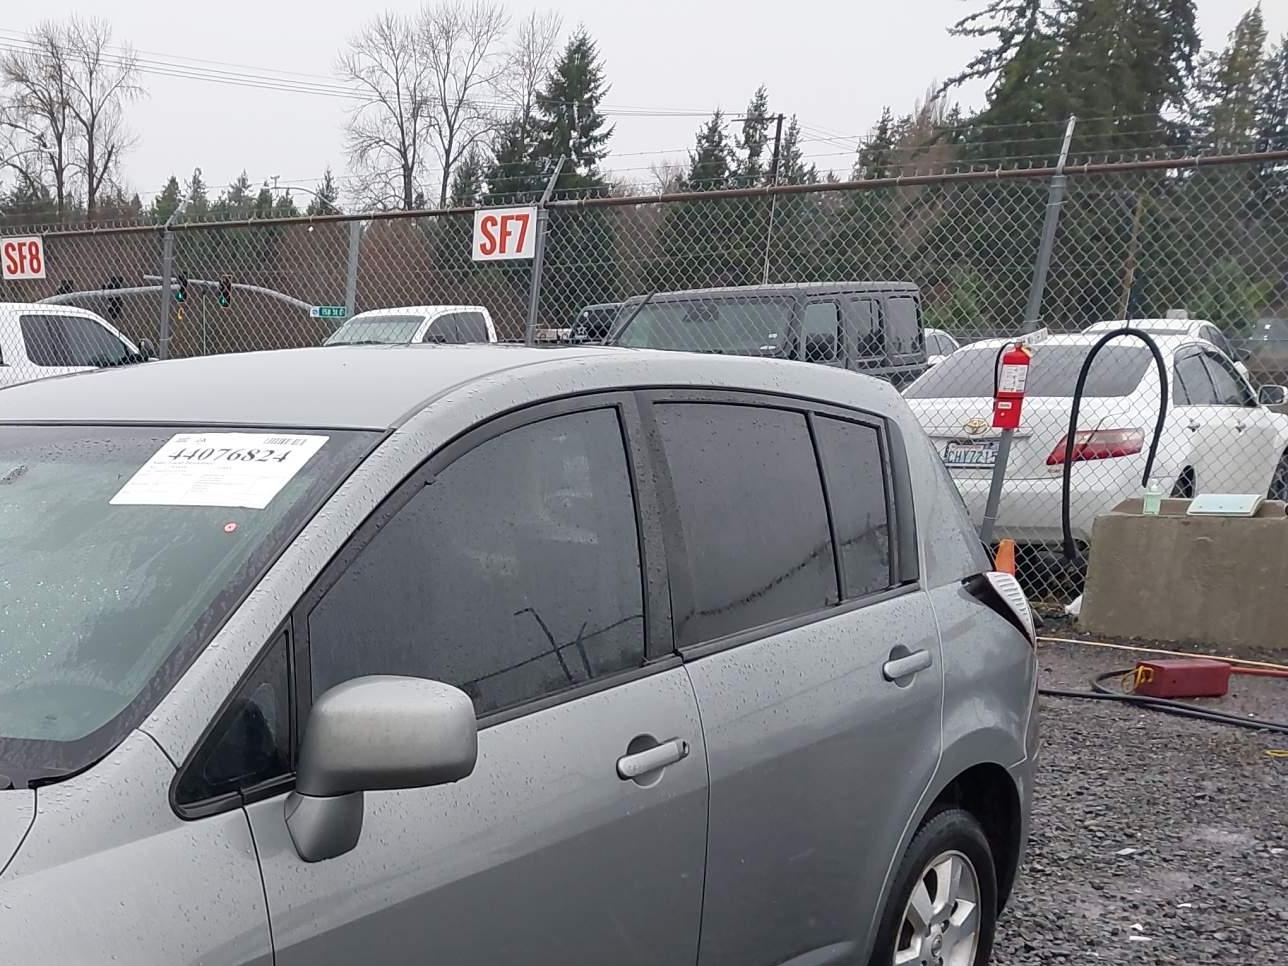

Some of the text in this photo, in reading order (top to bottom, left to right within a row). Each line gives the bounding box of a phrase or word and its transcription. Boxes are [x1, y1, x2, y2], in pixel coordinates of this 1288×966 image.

[480, 213, 530, 256] SF7
[4, 241, 42, 275] SF8
[168, 448, 292, 463] 44076824
